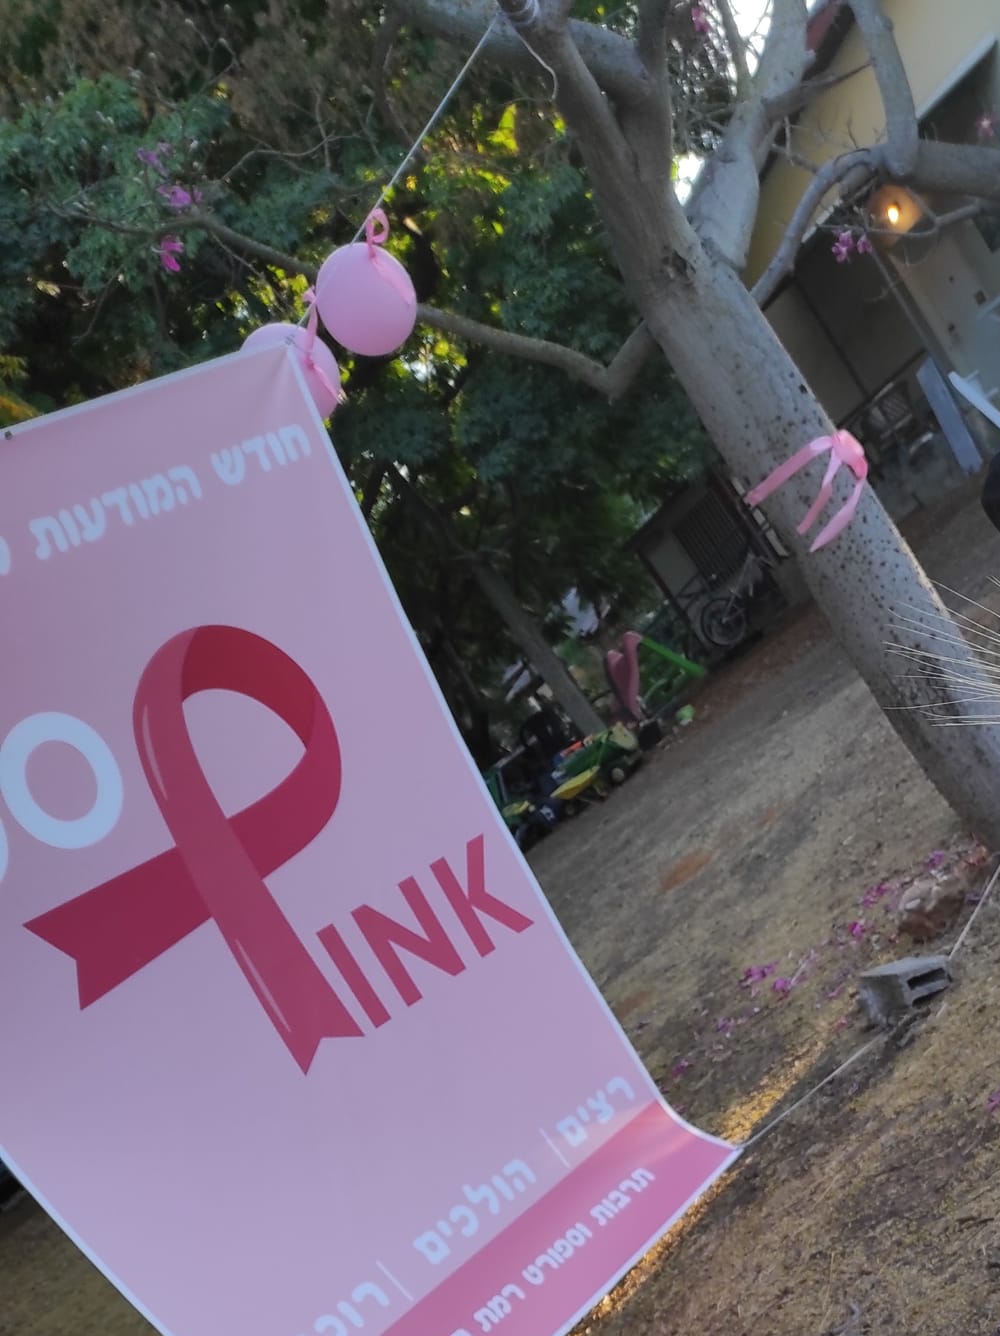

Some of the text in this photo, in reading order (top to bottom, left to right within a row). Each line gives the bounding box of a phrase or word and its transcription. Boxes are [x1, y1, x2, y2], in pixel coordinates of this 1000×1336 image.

[210, 423, 313, 486] חודש
[28, 463, 203, 561] המודעות
[555, 1076, 636, 1147] רצים
[412, 1158, 537, 1265] הולכים
[589, 1167, 655, 1227] תרבות
[521, 1222, 593, 1286] וספורט
[473, 1283, 527, 1333] רמת
